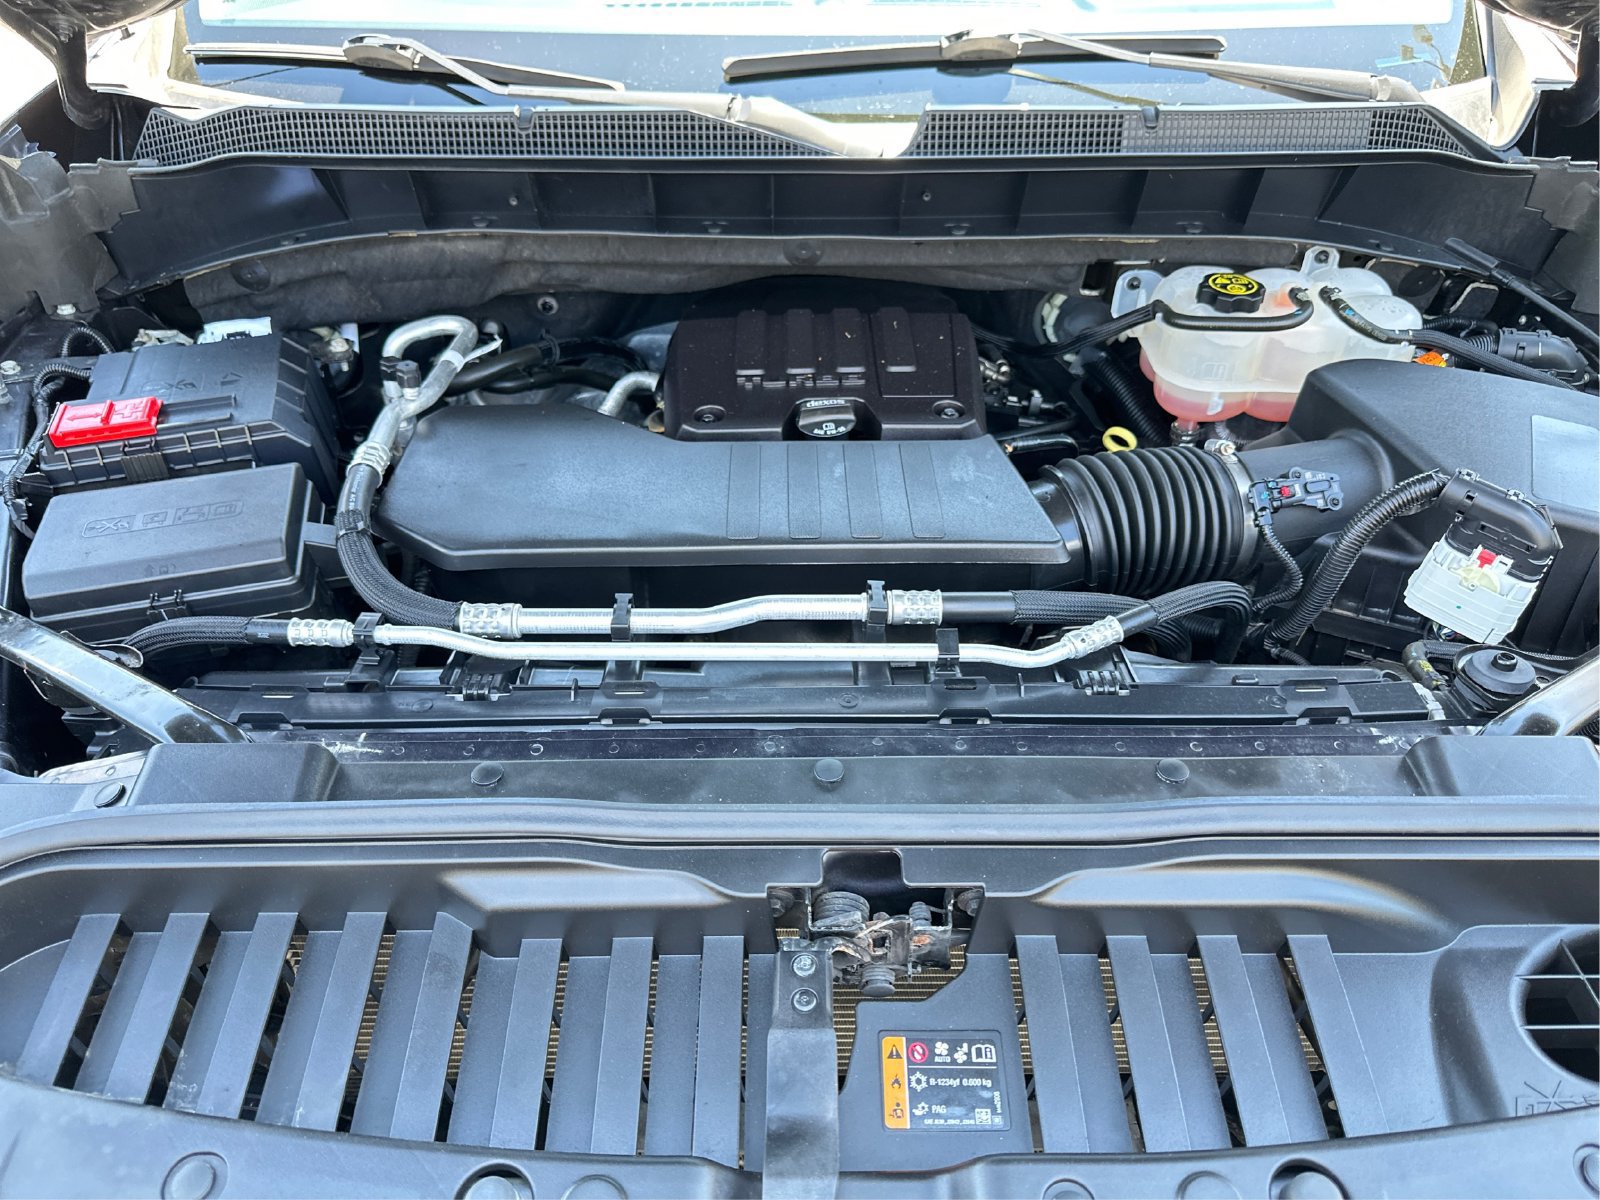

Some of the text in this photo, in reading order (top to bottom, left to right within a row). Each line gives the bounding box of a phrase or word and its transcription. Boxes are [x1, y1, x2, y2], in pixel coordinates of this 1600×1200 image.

[806, 399, 845, 408] dexos
[982, 1078, 992, 1088] kg
[931, 1105, 946, 1113] PAG
